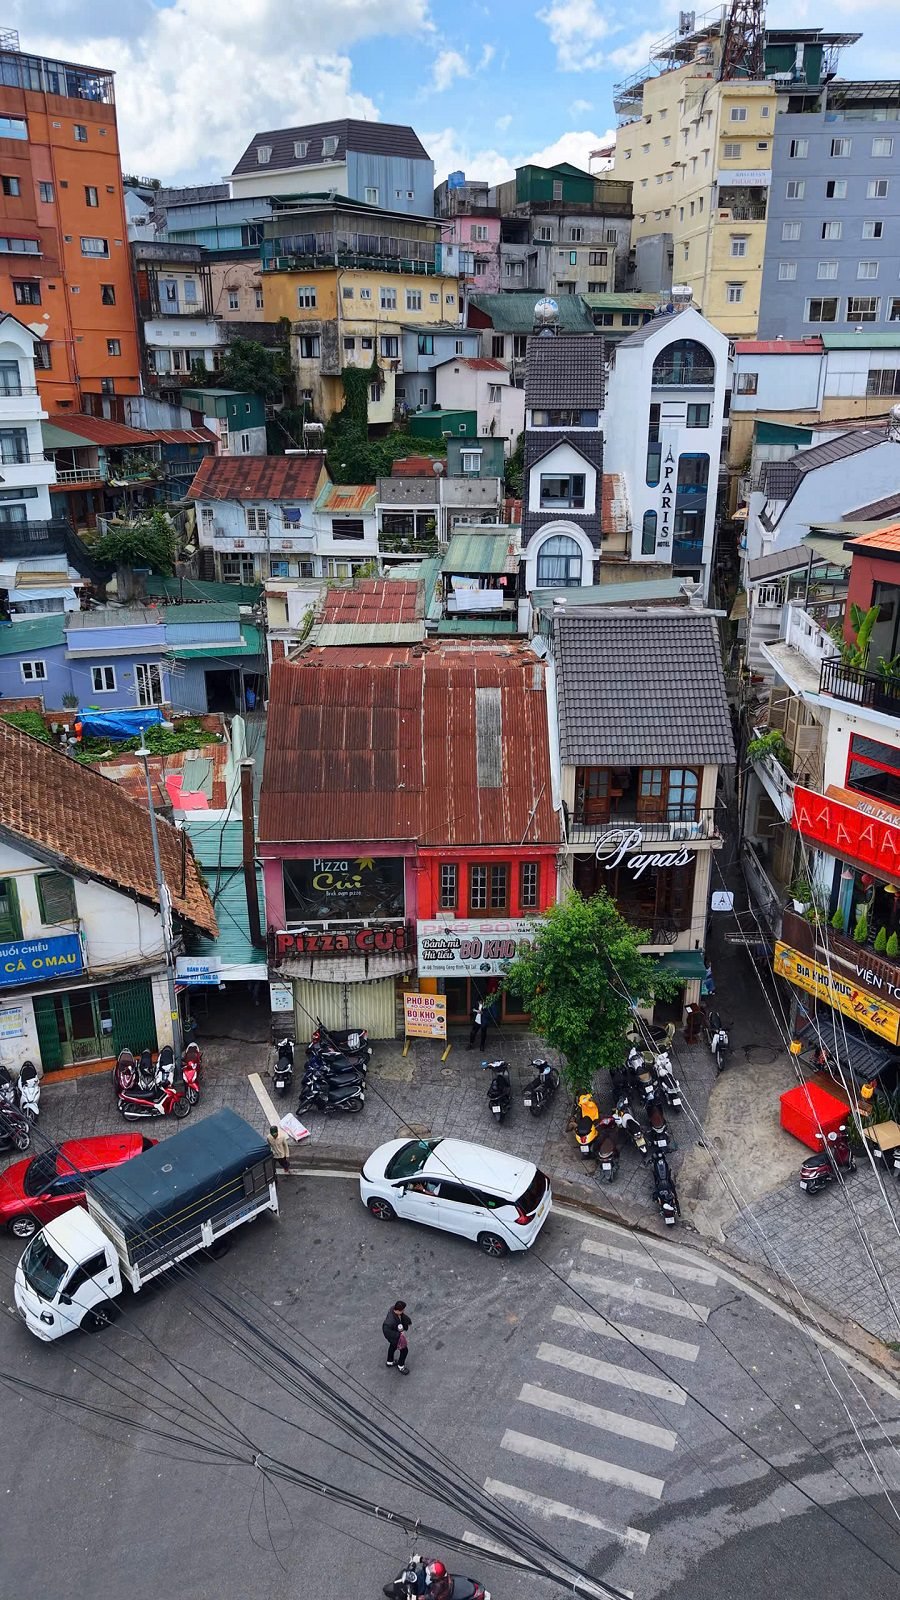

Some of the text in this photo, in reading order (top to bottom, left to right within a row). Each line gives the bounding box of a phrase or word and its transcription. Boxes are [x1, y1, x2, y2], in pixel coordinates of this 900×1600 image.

[660, 466, 675, 538] PARIS
[857, 801, 875, 815] KIRI
[594, 827, 696, 880] Papa's
[313, 858, 348, 872] Pizza
[277, 933, 349, 953] Pizza
[422, 938, 446, 949] Bánh
[483, 939, 516, 959] KHO
[855, 964, 882, 989] VIỆN
[419, 1011, 435, 1019] KHO
